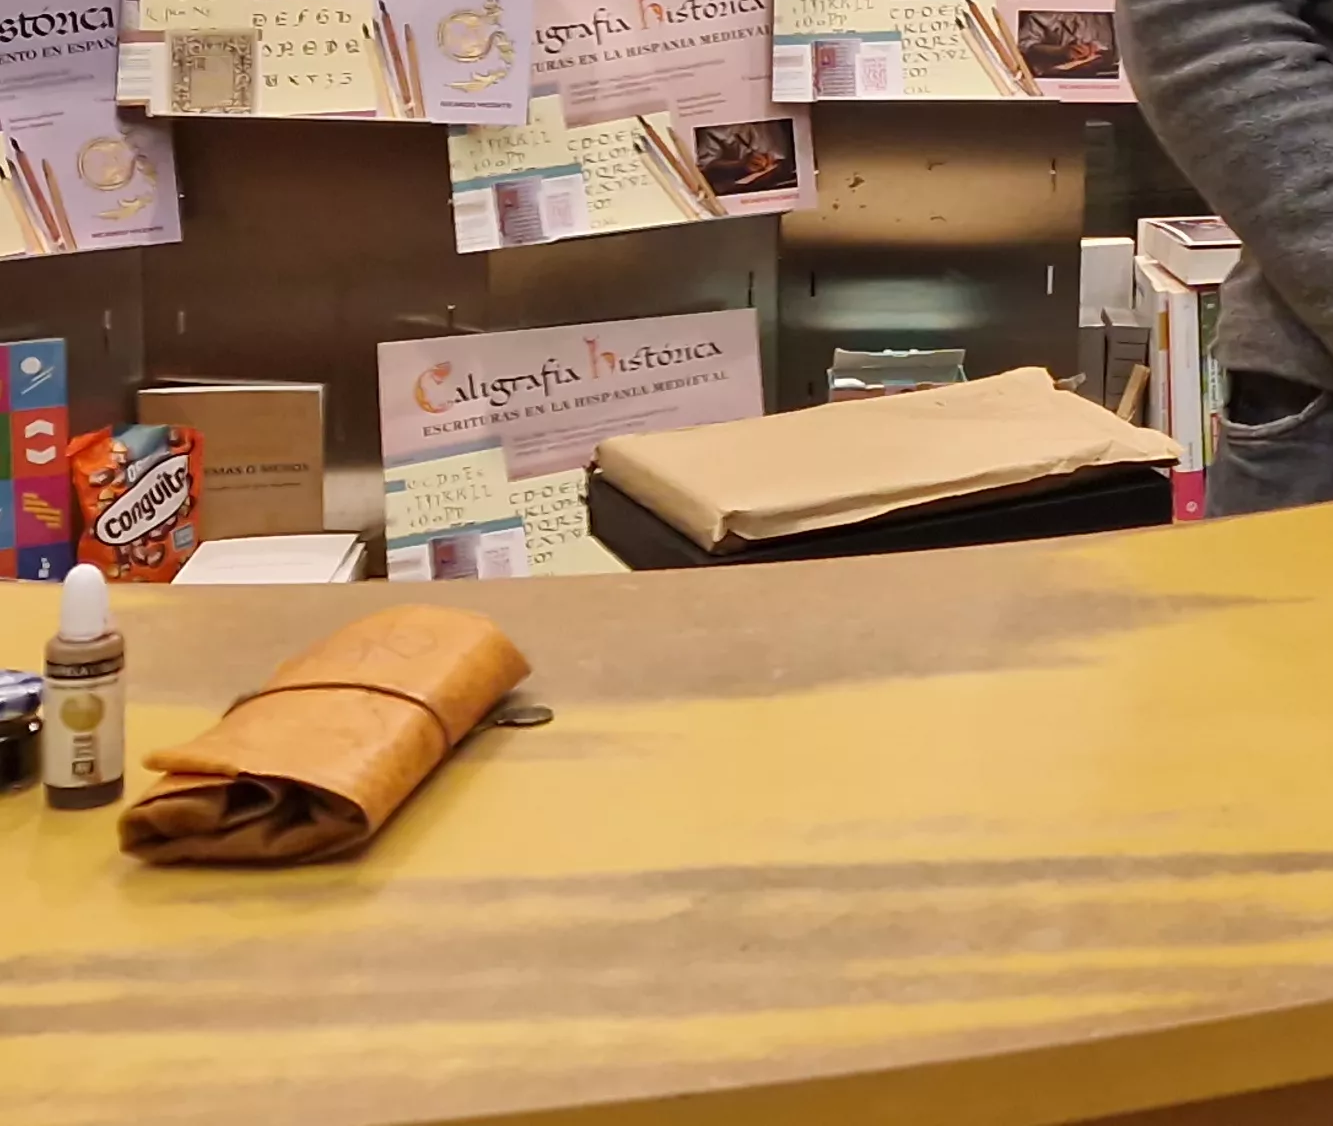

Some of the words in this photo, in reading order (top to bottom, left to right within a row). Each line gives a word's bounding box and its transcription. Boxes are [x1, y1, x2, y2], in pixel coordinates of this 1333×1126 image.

[43, 46, 62, 58] EN
[579, 52, 597, 65] EN
[603, 49, 620, 62] LA
[625, 40, 695, 60] HISPANIA
[414, 361, 578, 415] Caligrafía
[422, 412, 519, 437] ESCRITURAS
[525, 406, 545, 422] EN
[551, 403, 572, 418] LA
[575, 389, 649, 413] HISPANIA
[653, 371, 729, 398] MEDIEVAL
